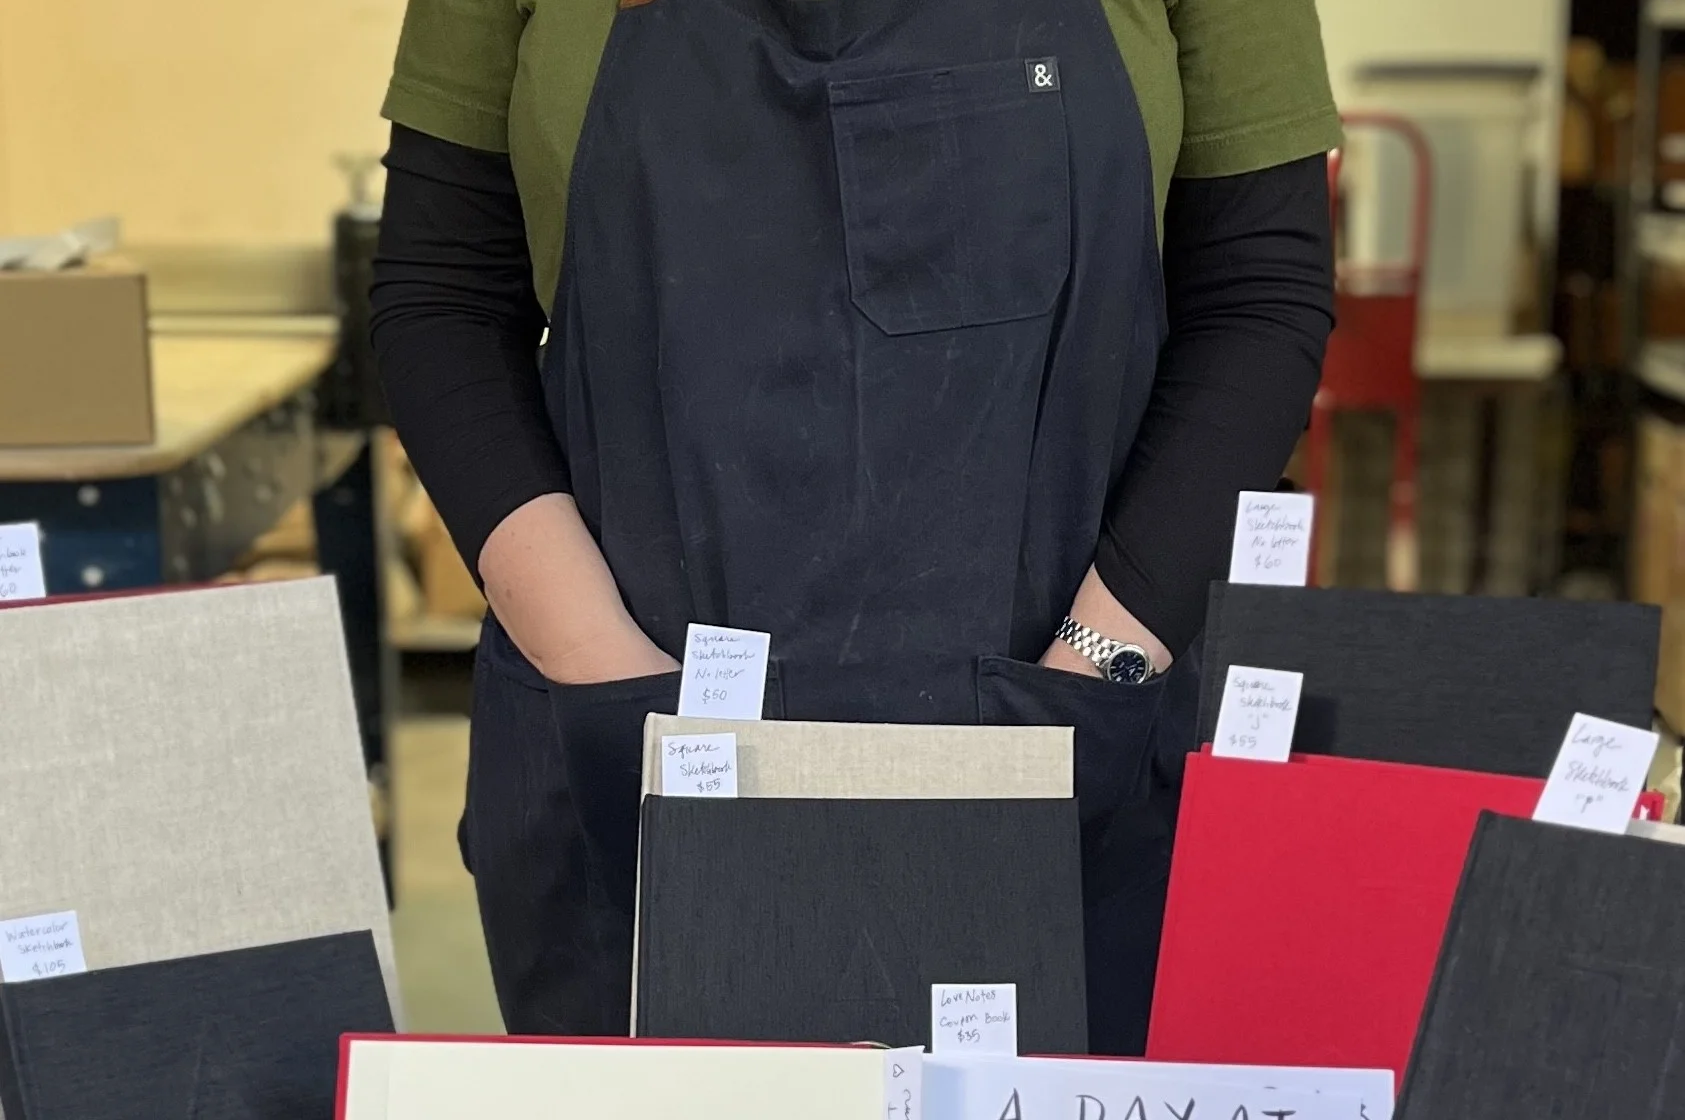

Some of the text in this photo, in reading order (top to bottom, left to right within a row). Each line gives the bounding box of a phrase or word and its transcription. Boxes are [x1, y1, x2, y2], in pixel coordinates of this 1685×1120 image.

[1034, 63, 1052, 87] &
[1253, 553, 1281, 570] $60
[1571, 722, 1622, 758] Large
[667, 741, 721, 760] Square
[696, 777, 721, 793] $55
[32, 959, 66, 976] $105
[941, 989, 996, 1007] Love Notes
[957, 1028, 981, 1043] $35
